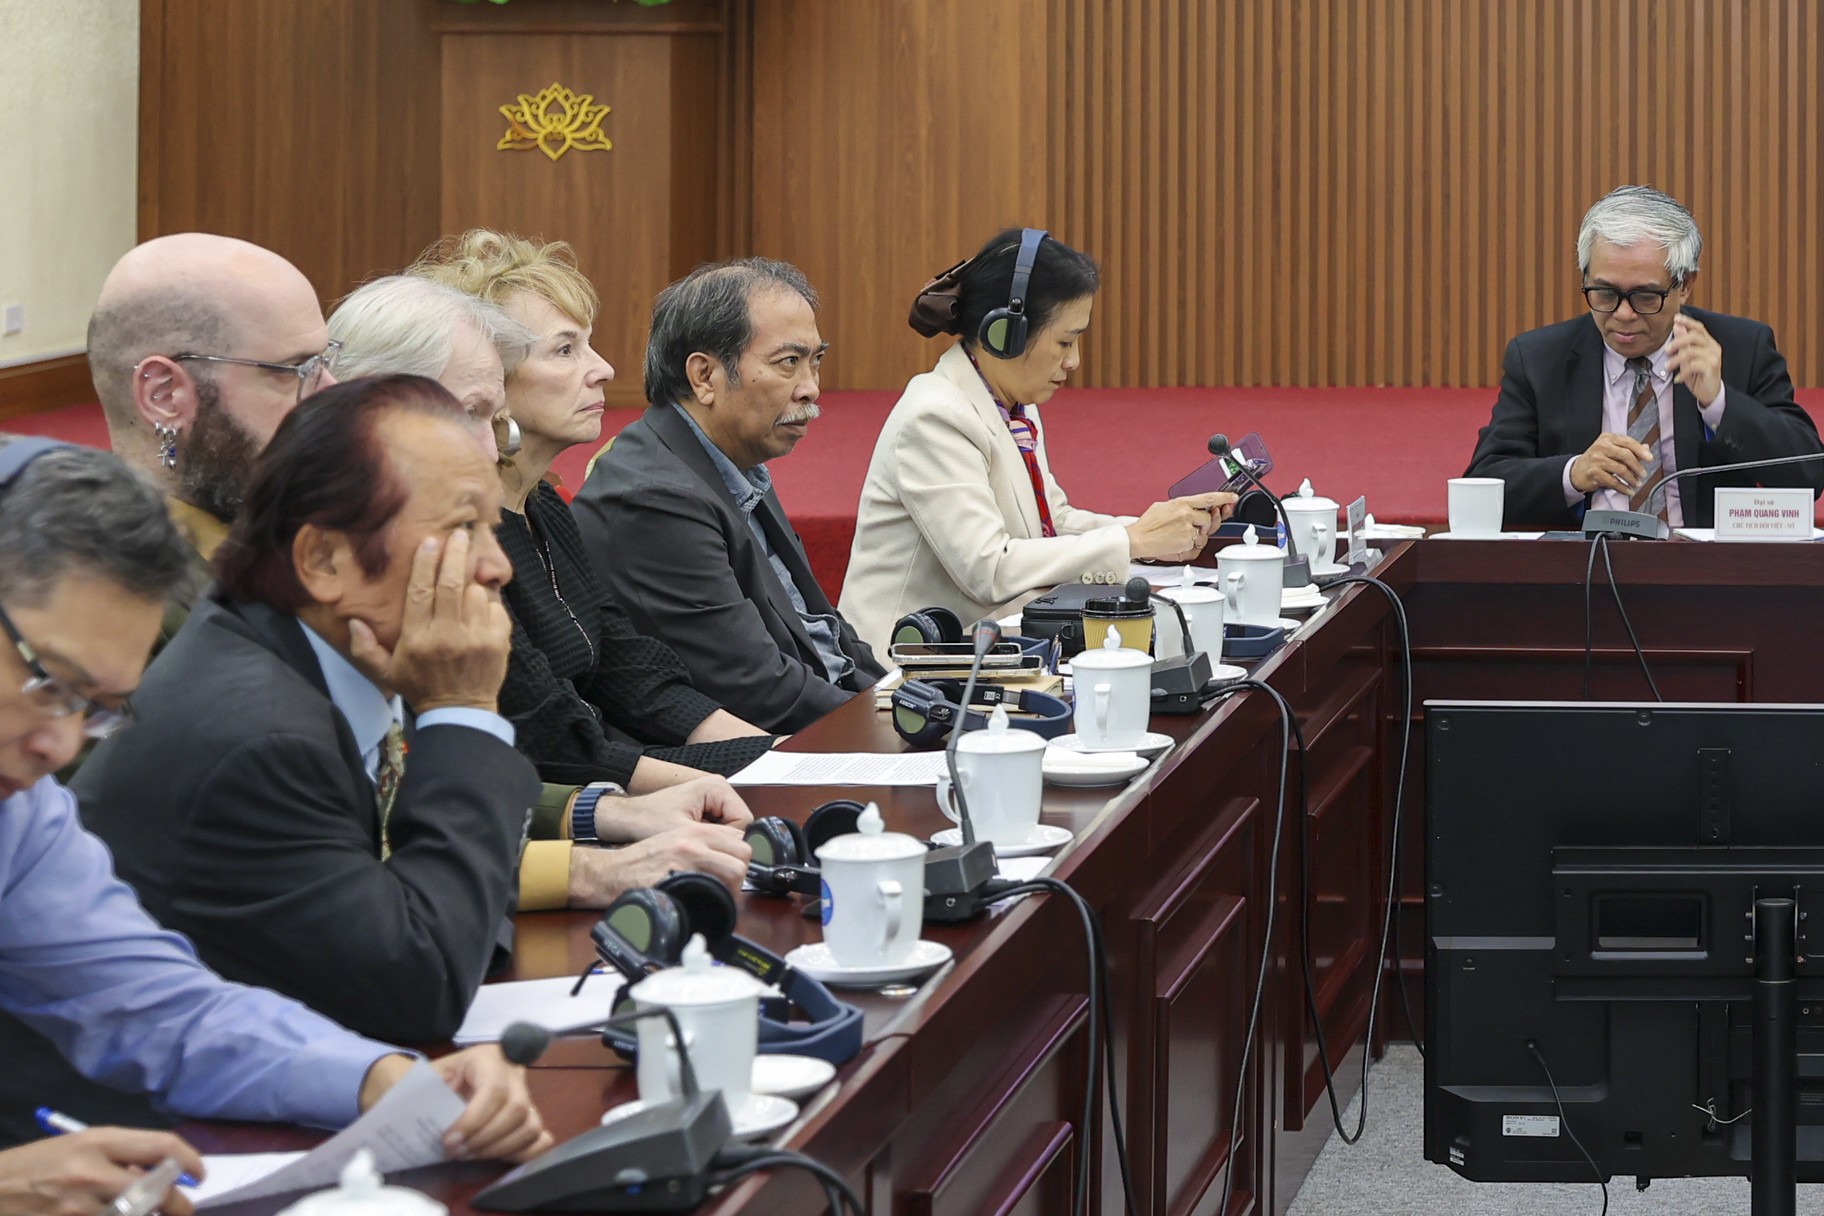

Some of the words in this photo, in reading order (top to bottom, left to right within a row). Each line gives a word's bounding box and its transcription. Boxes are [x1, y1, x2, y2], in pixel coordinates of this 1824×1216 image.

[1729, 508, 1752, 520] PHẠM
[1753, 508, 1780, 519] QUANG
[1781, 509, 1800, 519] VINH
[1609, 518, 1641, 528] PHILIPS
